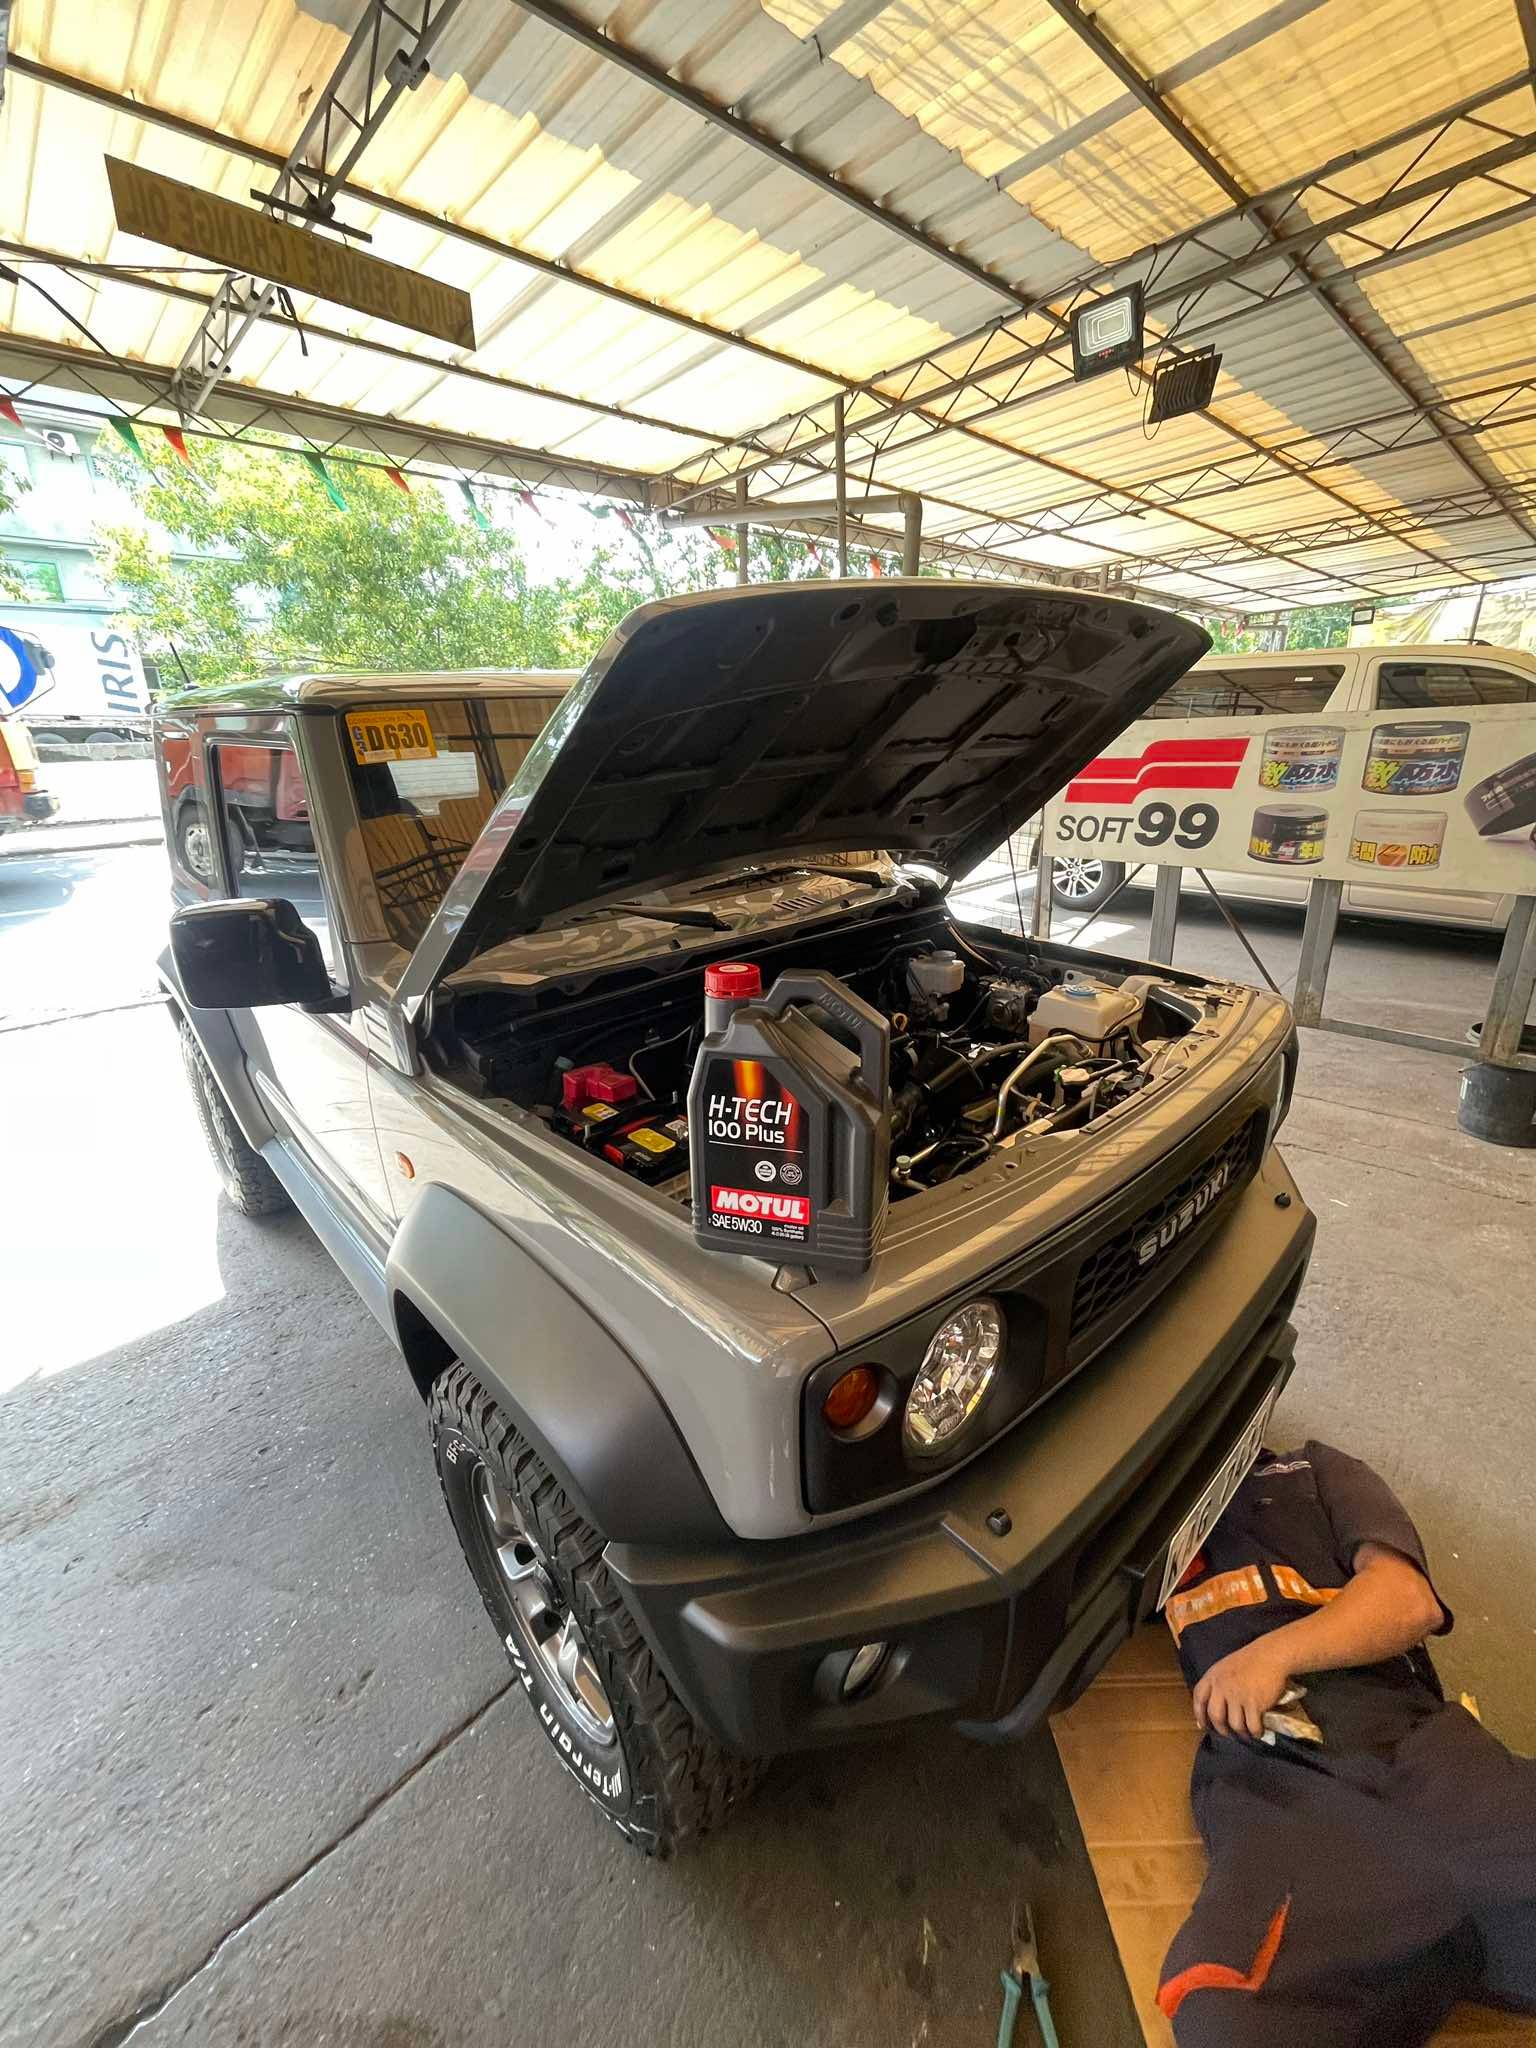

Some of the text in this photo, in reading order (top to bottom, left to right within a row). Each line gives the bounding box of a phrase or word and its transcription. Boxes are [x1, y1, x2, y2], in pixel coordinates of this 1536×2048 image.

[90, 632, 141, 713] IRIS
[365, 722, 429, 751] D630
[708, 1094, 793, 1125] H-TECH
[708, 1119, 785, 1144] 100 Plus
[715, 1190, 805, 1220] MOTUL
[1136, 1163, 1230, 1266] SUZUKI
[711, 1213, 732, 1230] SAE
[732, 1216, 763, 1234] 5W30
